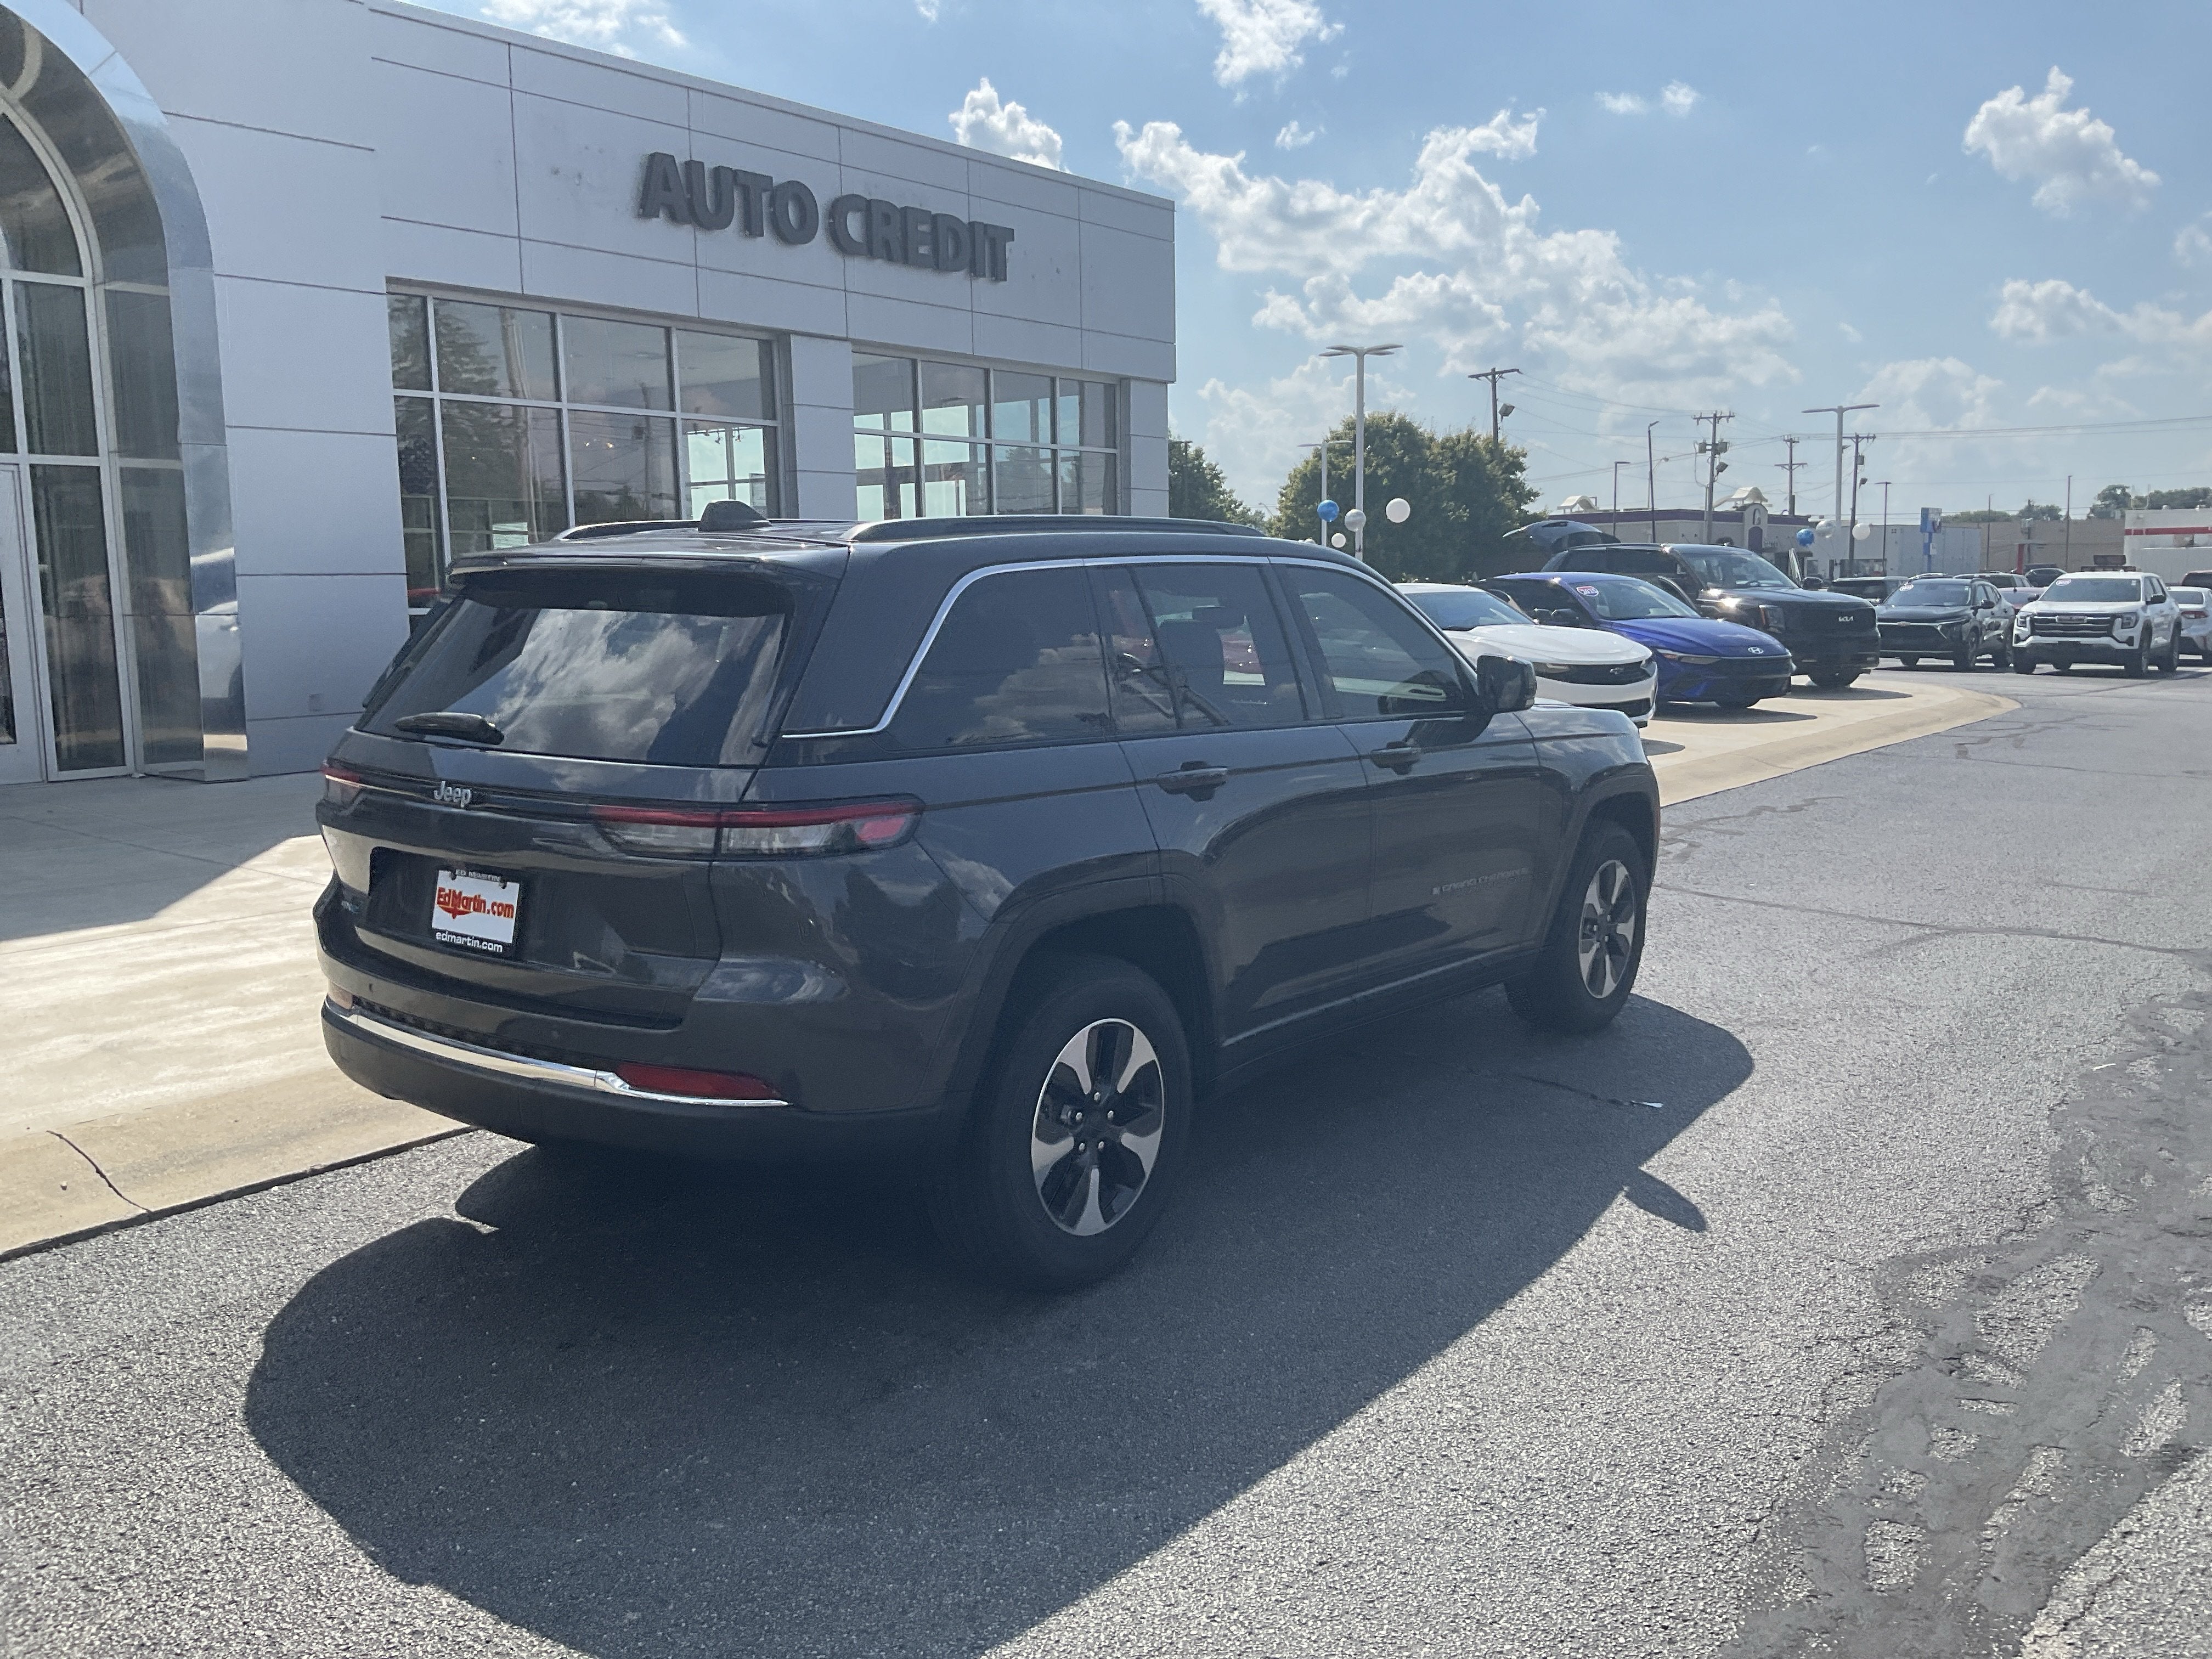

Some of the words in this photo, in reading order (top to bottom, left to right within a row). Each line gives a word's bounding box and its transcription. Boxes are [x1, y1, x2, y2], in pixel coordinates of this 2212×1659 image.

[639, 152, 819, 245] AUTO
[828, 194, 1014, 281] CREDIT
[433, 781, 471, 808] Jeep
[469, 871, 500, 882] MARTIN
[437, 887, 515, 918] EdMartin.com
[436, 931, 503, 953] edmartin.com
